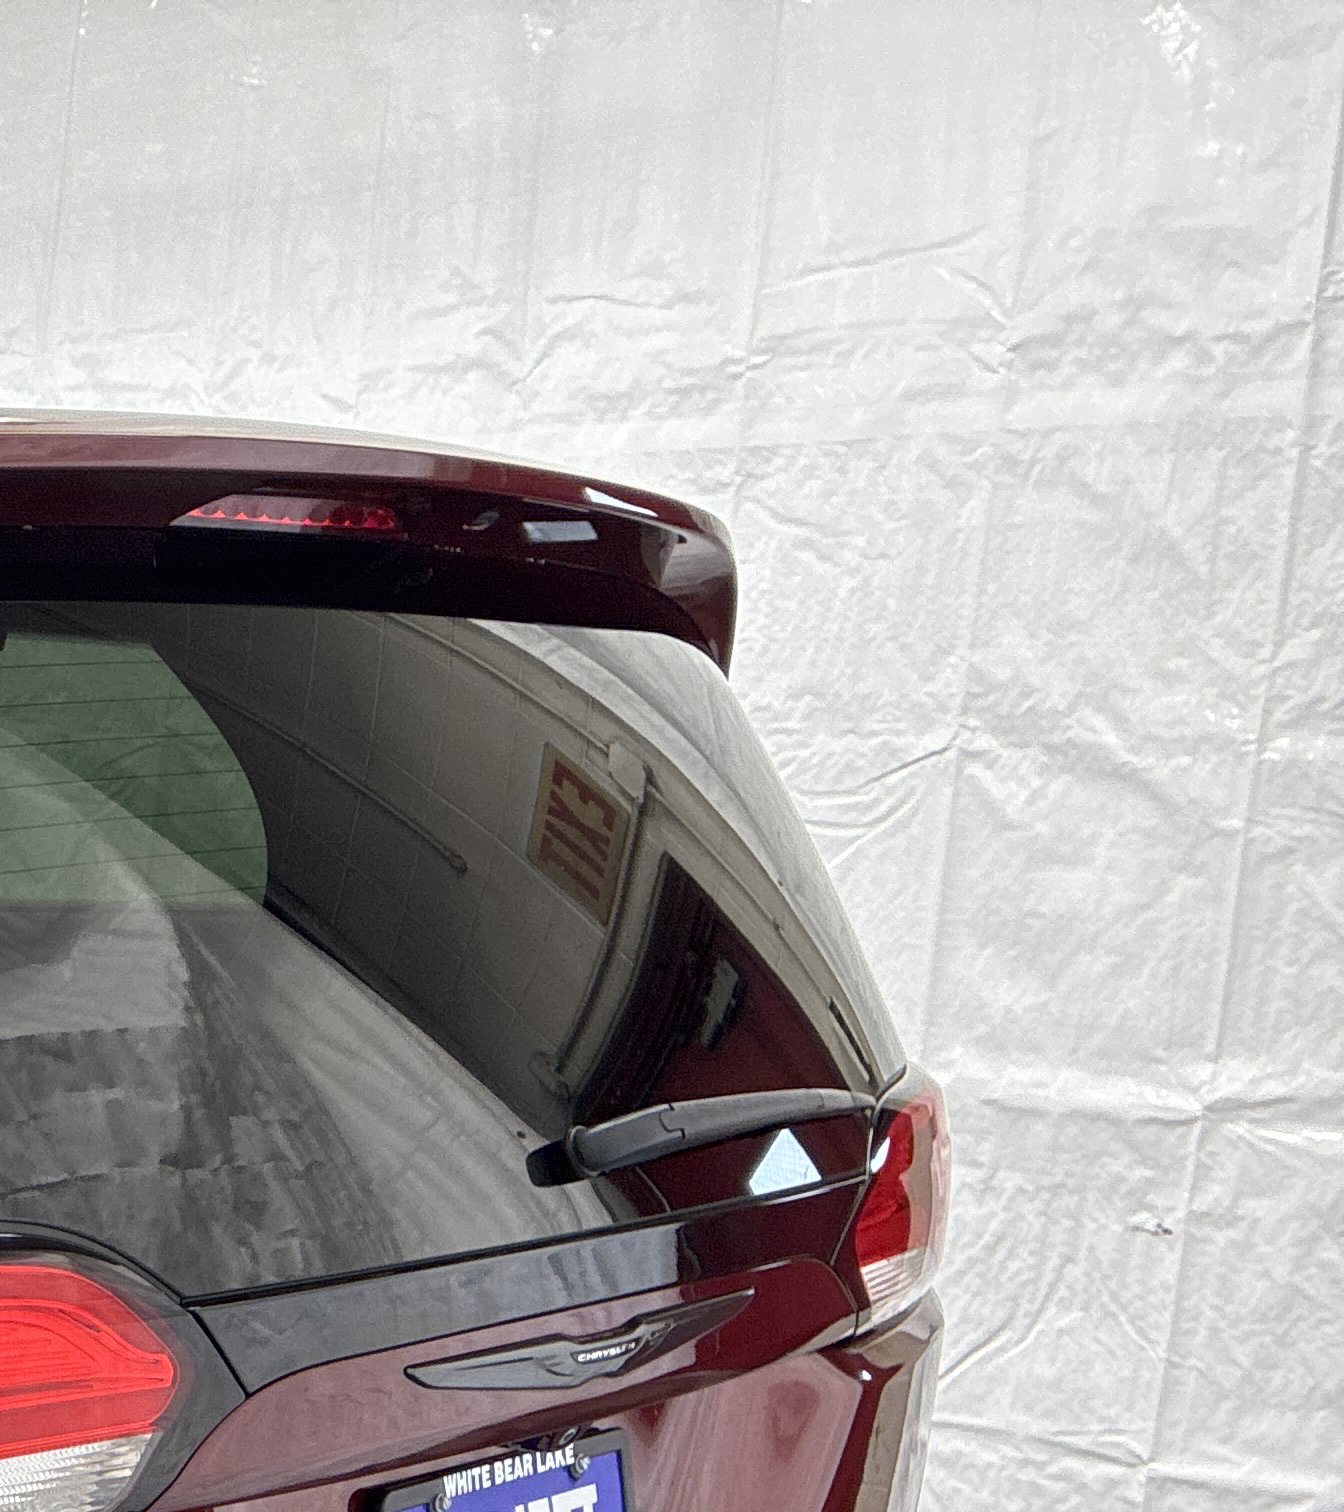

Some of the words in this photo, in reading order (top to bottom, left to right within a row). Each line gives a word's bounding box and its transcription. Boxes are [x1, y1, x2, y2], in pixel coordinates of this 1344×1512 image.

[443, 1464, 492, 1499] WHITE
[493, 1452, 534, 1486] BEAR
[535, 1442, 575, 1473] LAKE
